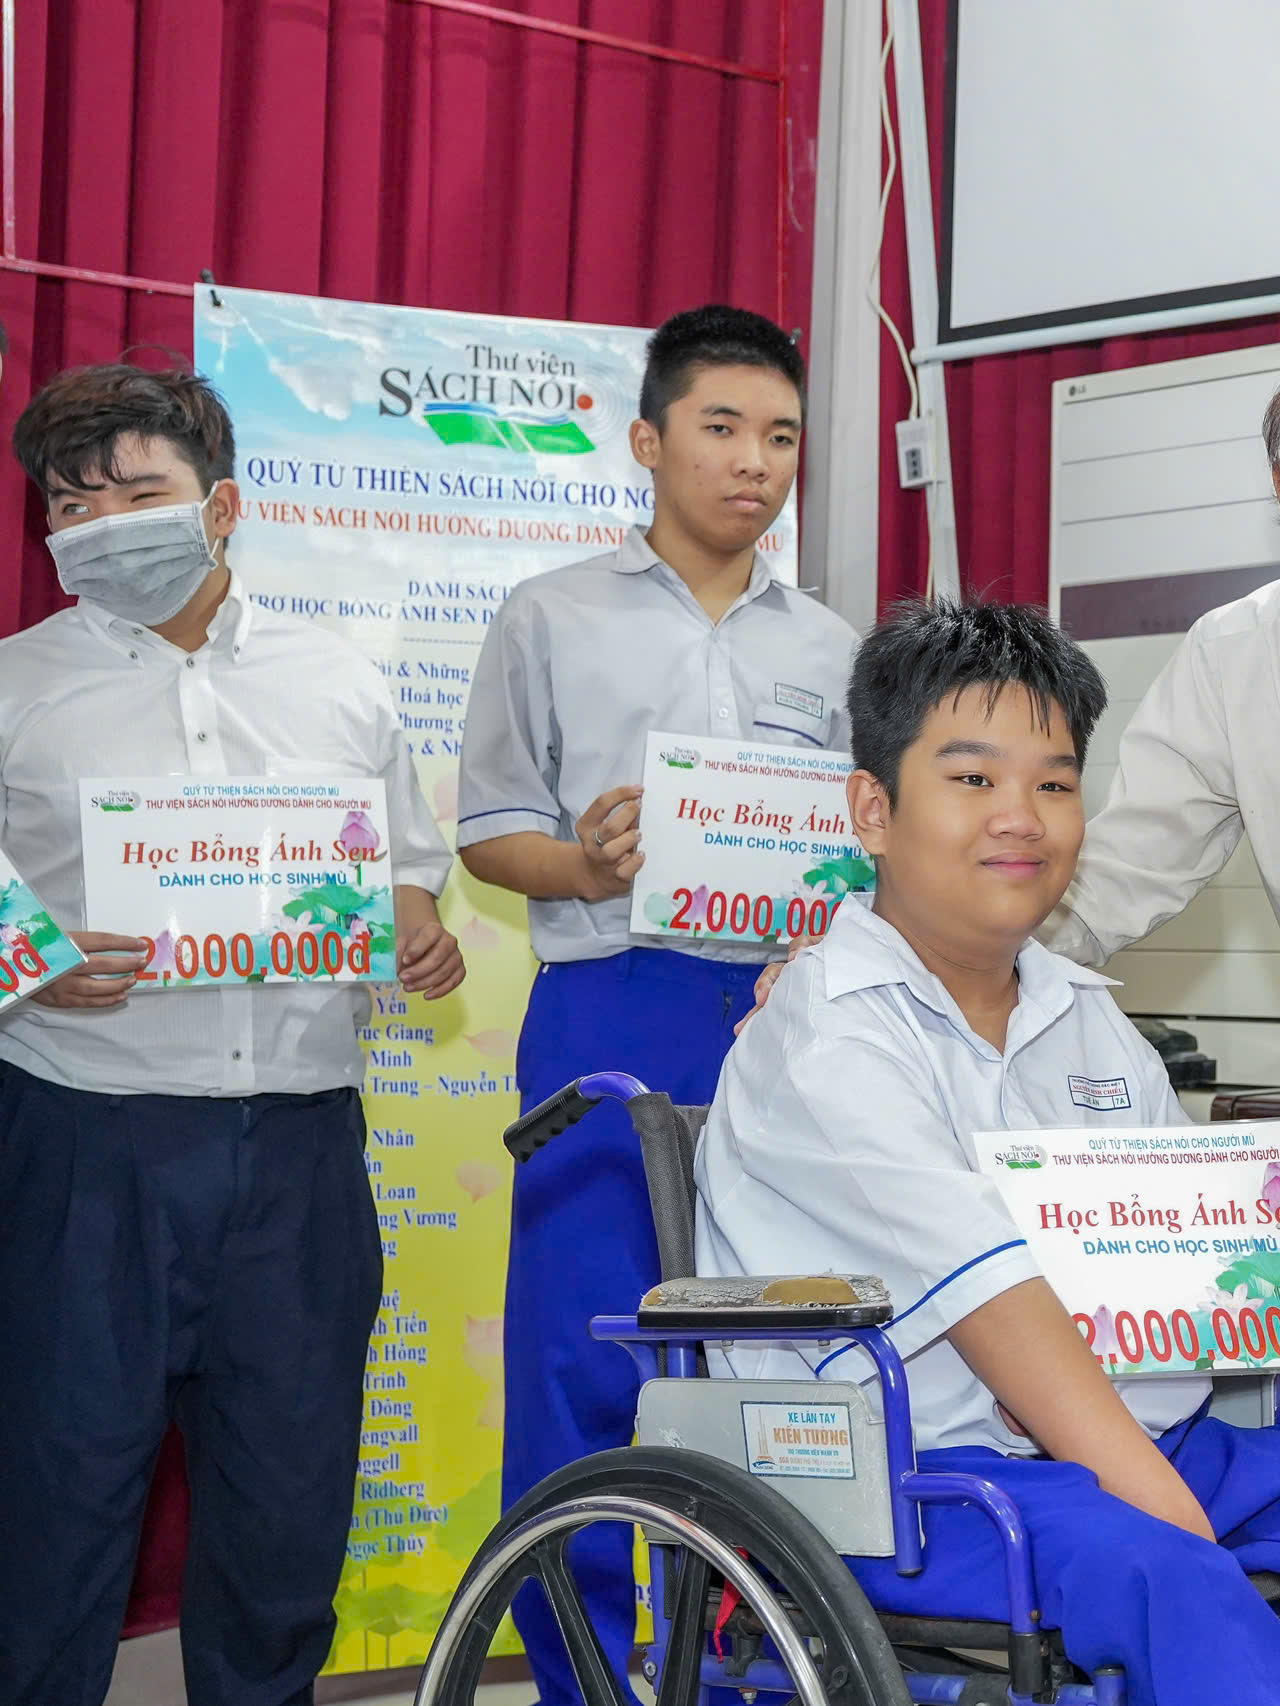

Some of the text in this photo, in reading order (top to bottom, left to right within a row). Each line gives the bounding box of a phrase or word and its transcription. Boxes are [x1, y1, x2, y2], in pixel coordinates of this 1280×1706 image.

[465, 344, 576, 377] Thư viện
[379, 366, 498, 417] SÁCH
[353, 465, 430, 496] THIỆN
[439, 470, 504, 500] SÁCH
[565, 482, 616, 507] CHO
[408, 580, 460, 599] DANH
[291, 598, 330, 619] HỌC
[442, 608, 476, 624] SEN
[397, 661, 411, 677] &
[400, 686, 464, 709] Hoá học
[705, 760, 719, 770] THƯ
[721, 762, 737, 773] VIỆN
[739, 762, 759, 774] SÁCH
[820, 761, 835, 771] CHO
[282, 786, 299, 796] CHO
[146, 800, 164, 809] THƯ
[167, 799, 185, 810] VIỆN
[189, 798, 210, 809] SÁCH
[261, 799, 290, 808] DƯƠNG
[316, 799, 332, 808] CHO
[676, 798, 845, 835] Học Bổng Ánh
[121, 832, 377, 870] Học Bổng Ánh Sen
[704, 831, 862, 858] DÀNH CHO HỌC SINH MÙ
[159, 870, 347, 887] DÀNH CHO HỌC SINH MÙ
[669, 887, 842, 938] 2.000.00
[135, 930, 372, 981] 2.000.000đ
[386, 1024, 434, 1045] Giang
[370, 1050, 412, 1067] Minh
[371, 1076, 418, 1097] Trung
[439, 1071, 497, 1097] Nguyễn
[373, 1129, 414, 1147] Nhân
[1123, 1138, 1147, 1152] THIỆN
[1149, 1136, 1173, 1150] SÁCH
[1175, 1136, 1189, 1149] NÓI
[1191, 1138, 1209, 1148] CHO
[1212, 1134, 1240, 1148] NGƯỜI
[1242, 1132, 1255, 1146] MÙ
[1052, 1155, 1072, 1166] THƯ
[1074, 1153, 1094, 1167] VIỆN
[1097, 1151, 1119, 1164] SÁCH
[1121, 1152, 1136, 1164] NÓI
[1138, 1149, 1169, 1164] HƯỚNG
[1170, 1152, 1203, 1164] DƯƠNG
[1204, 1149, 1228, 1163] DÀNH
[1229, 1151, 1249, 1162] CHO
[1250, 1146, 1280, 1161] NGƯỜI
[376, 1183, 416, 1200] Loan
[403, 1209, 457, 1229] Vương
[1037, 1203, 1100, 1235] Học
[1107, 1193, 1182, 1234] Bổng
[1190, 1192, 1247, 1226] Ánh
[1083, 1235, 1278, 1256] DÀNH CHO HỌC SINH MÙ
[392, 1311, 427, 1335] Tiến
[787, 1412, 799, 1423] XE
[820, 1412, 836, 1423] TAY
[361, 1424, 418, 1447] engvall
[361, 1480, 424, 1500] Ridberg
